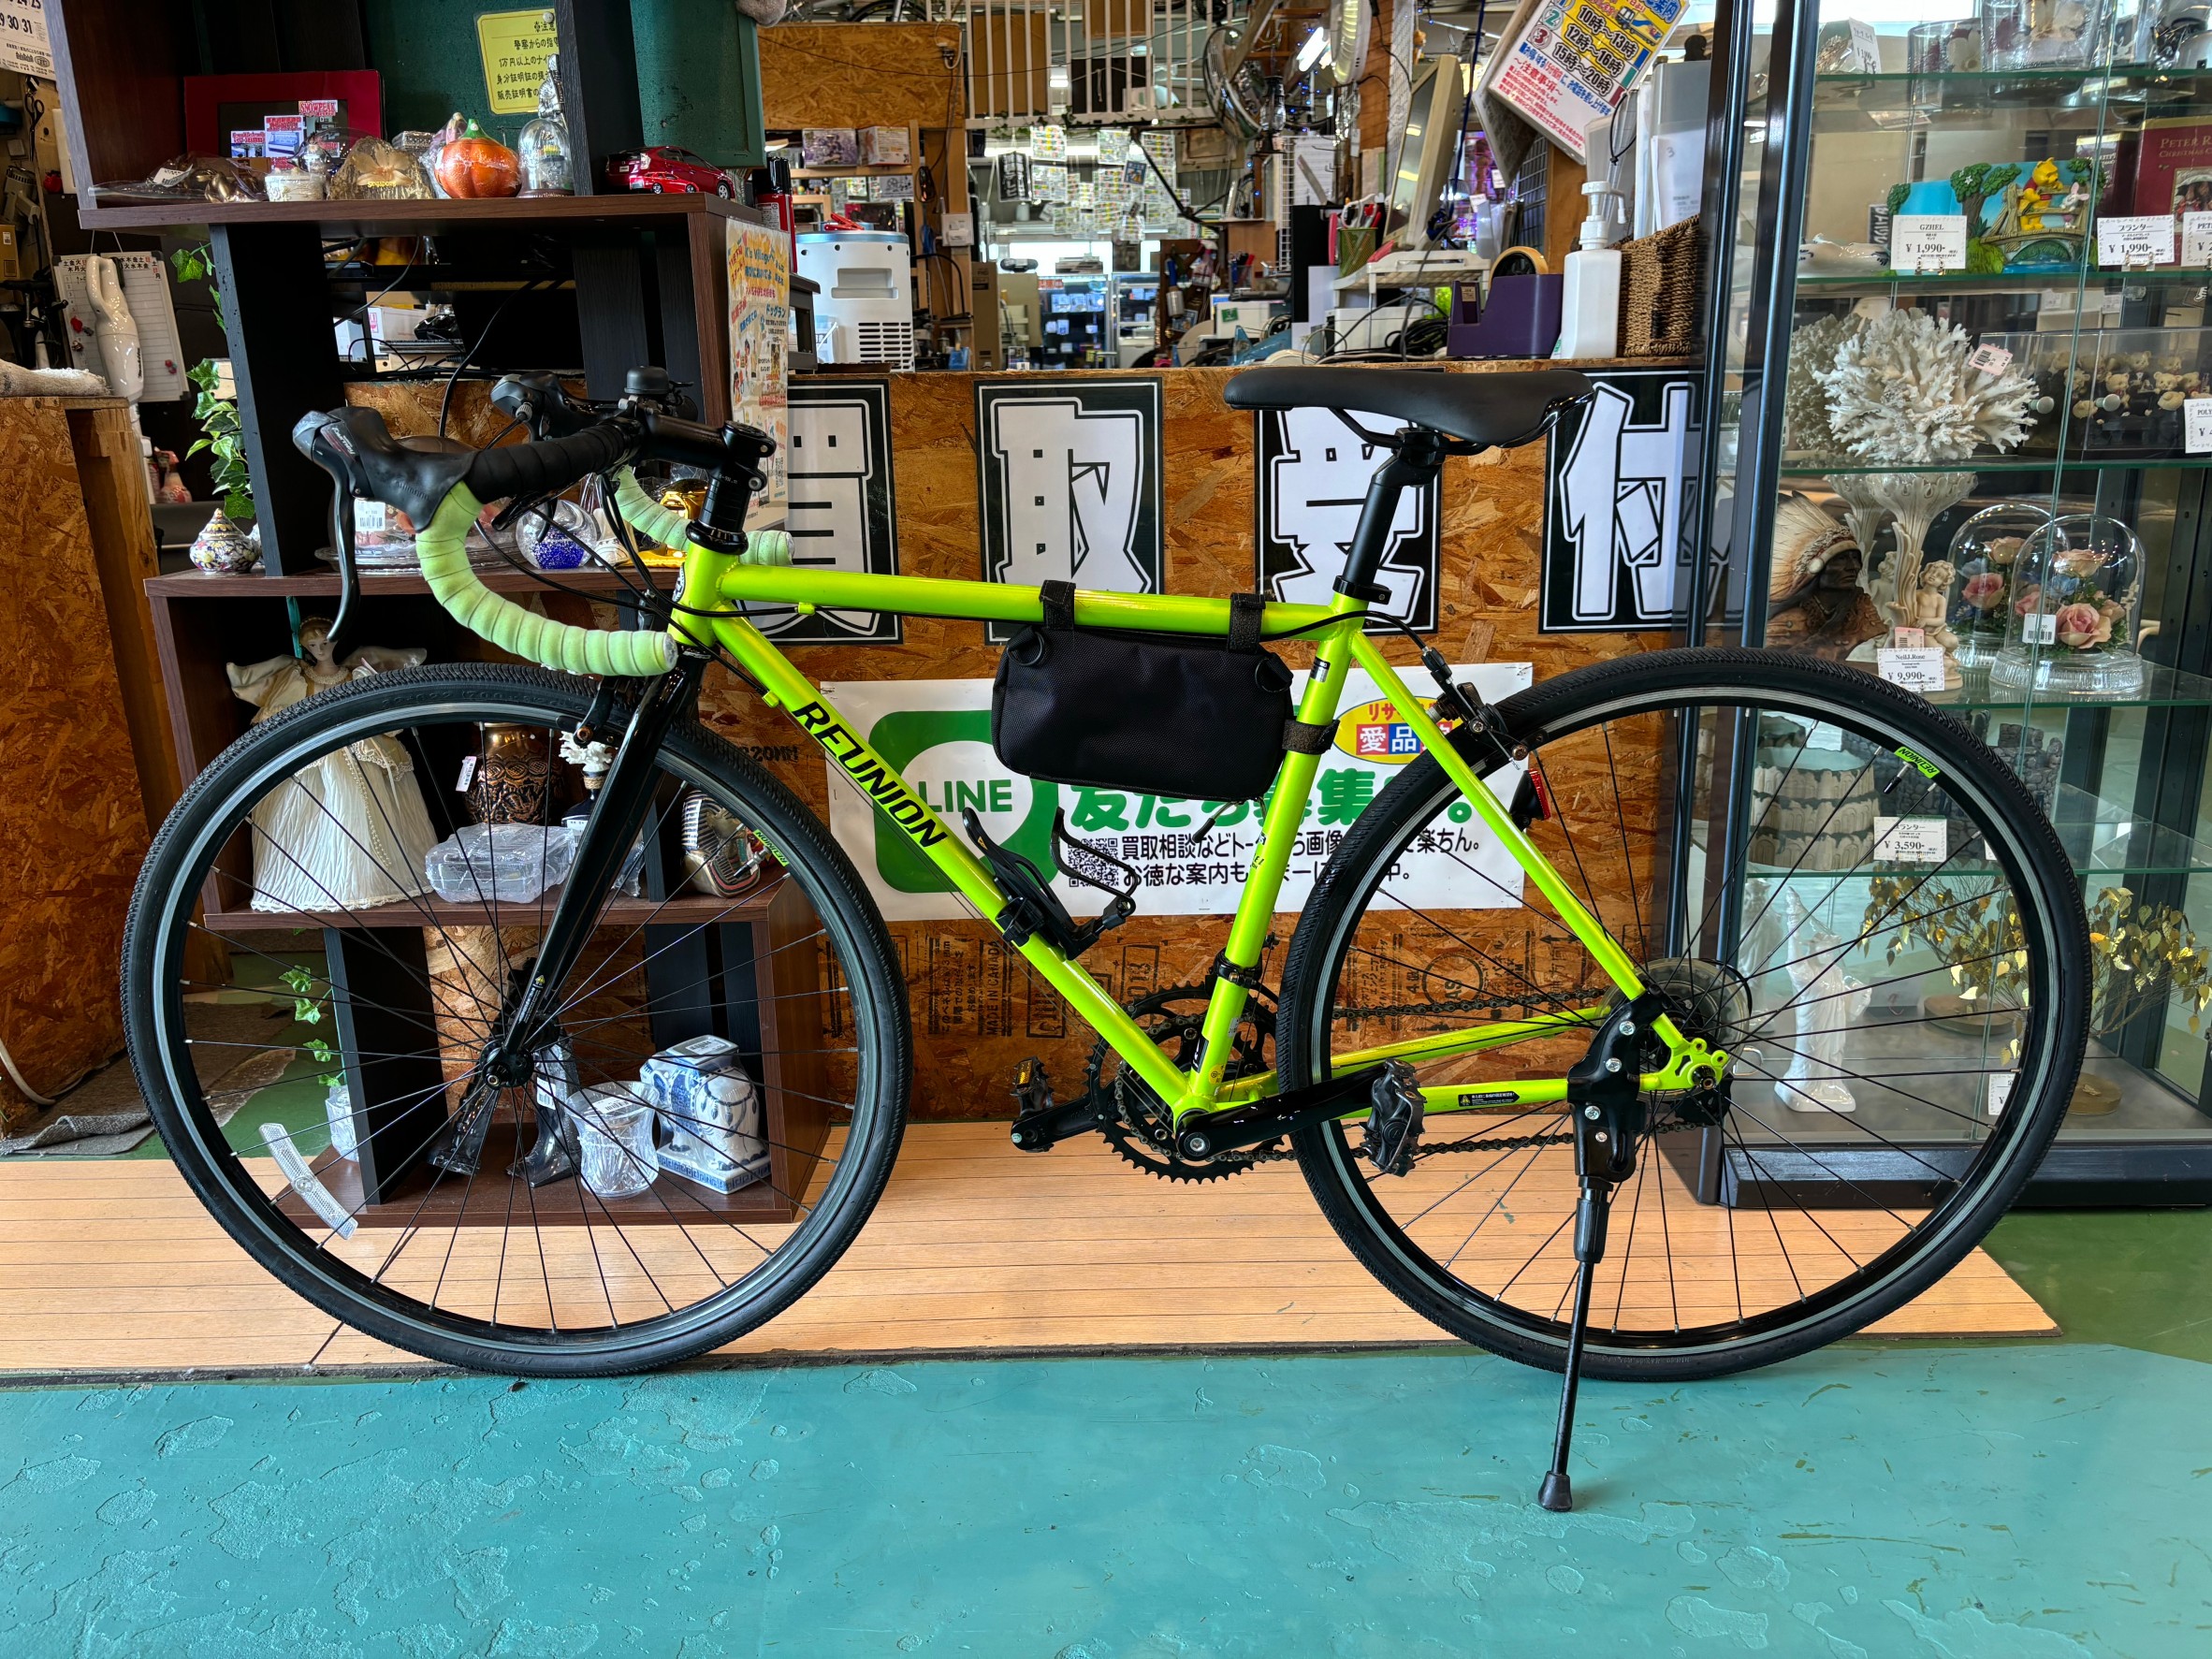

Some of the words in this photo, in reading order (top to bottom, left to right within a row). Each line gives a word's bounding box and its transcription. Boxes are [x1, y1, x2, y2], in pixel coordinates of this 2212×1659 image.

[7, 15, 19, 30] 30
[22, 19, 33, 34] 31
[1546, 10, 1557, 25] 2
[1535, 29, 1548, 45] 3
[499, 54, 550, 67] 1万円以上のナイ
[1905, 243, 1912, 253] ¥
[2108, 244, 2116, 253] ¥
[1887, 672, 1894, 680] ¥
[1899, 748, 1937, 774] REUNION
[792, 701, 949, 848] REUNION
[918, 779, 1012, 812] LINE
[756, 832, 789, 864] REUNION
[987, 940, 1000, 986] CANADA
[987, 990, 998, 1001] IN
[986, 1005, 998, 1035] MADE
